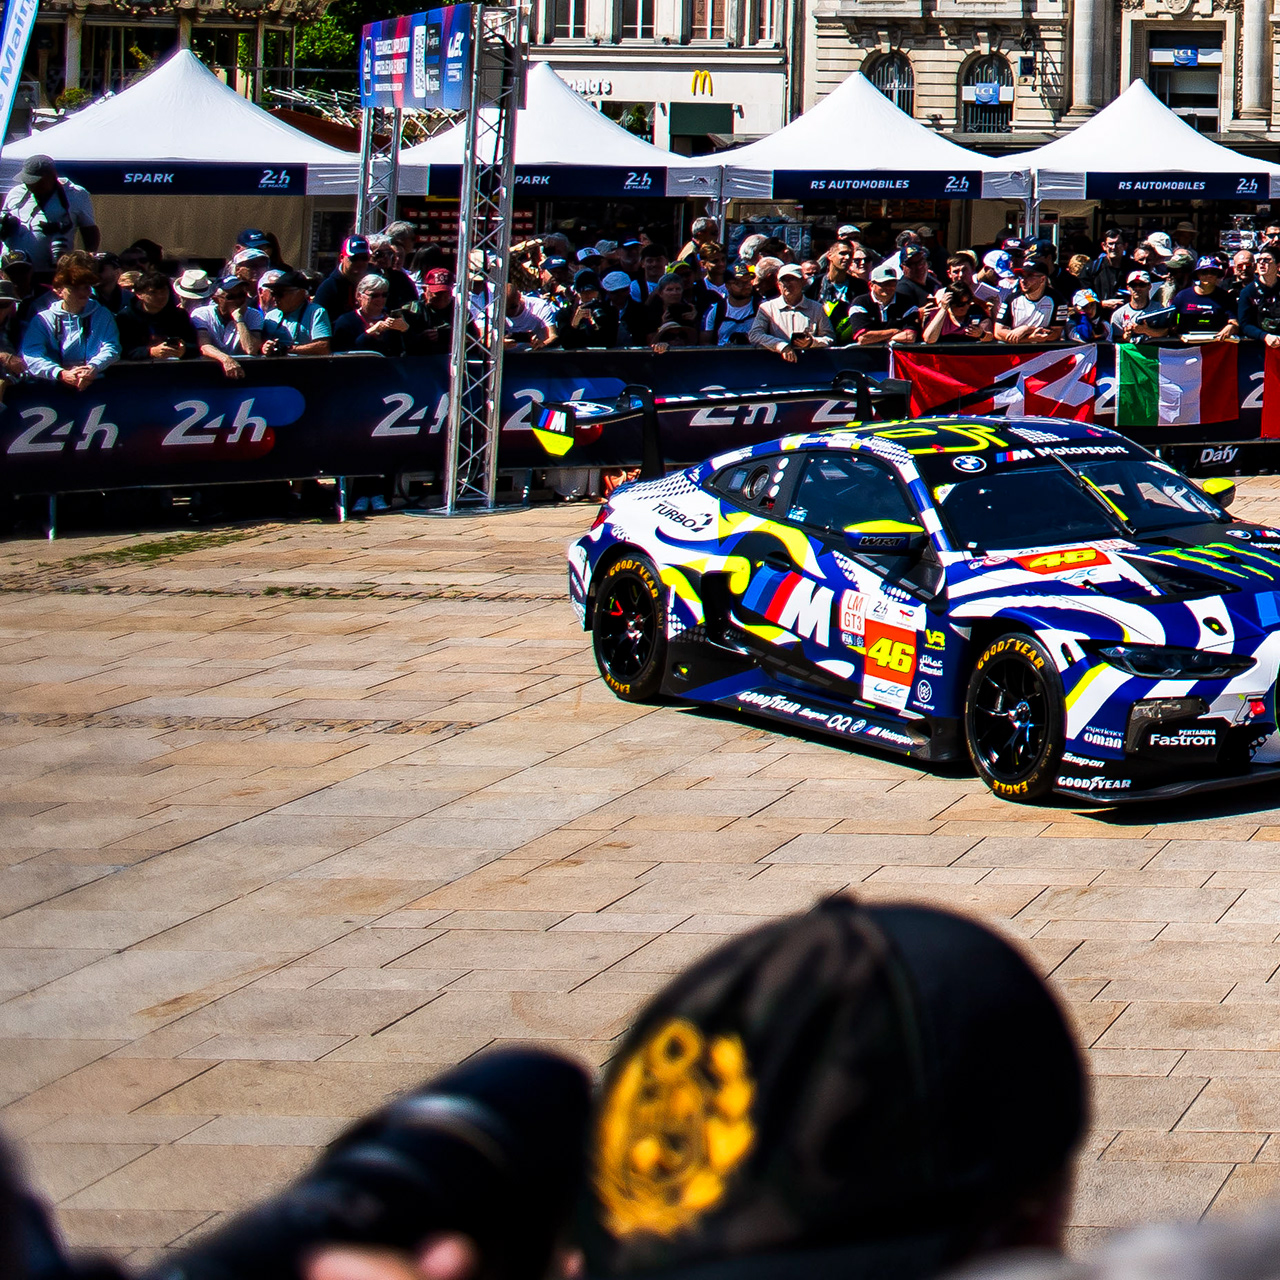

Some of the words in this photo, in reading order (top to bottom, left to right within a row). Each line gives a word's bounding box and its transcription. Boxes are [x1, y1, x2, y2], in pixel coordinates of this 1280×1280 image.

[1174, 49, 1195, 59] LCL
[566, 77, 613, 96] nald's
[975, 87, 997, 97] LCL
[123, 172, 175, 183] SPARK
[259, 169, 291, 184] 24h
[514, 175, 551, 185] PARK
[625, 171, 652, 185] 24h
[810, 180, 827, 190] RS
[827, 179, 911, 189] AUTOMOBILES
[945, 175, 970, 188] 24h
[1237, 177, 1259, 190] 24h
[1118, 181, 1133, 190] RS
[1134, 181, 1206, 190] AUTOMOBILES
[7, 403, 119, 454] 24h
[161, 397, 268, 446] 24h
[1036, 444, 1130, 459] Motorsport
[1200, 447, 1238, 468] Dafy
[652, 502, 696, 529] TURBO
[859, 535, 906, 547] WRT
[1028, 548, 1098, 569] 46
[609, 559, 659, 599] GOODYEAR
[847, 593, 864, 612] LM
[777, 581, 835, 648] M
[843, 611, 862, 631] GT3
[867, 636, 916, 674] 46
[976, 637, 1046, 671] GOODYEAR
[873, 682, 906, 698] WEC
[738, 691, 801, 715] GOODYEAR
[827, 713, 851, 732] OQ
[878, 727, 917, 746] Motorsport
[1085, 725, 1125, 738] experience
[1150, 734, 1217, 746] Fastron
[1083, 732, 1122, 750] oman
[1061, 751, 1106, 769] Snap-on
[992, 778, 1029, 796] EAGLE
[1057, 775, 1132, 791] GOODYEAR
